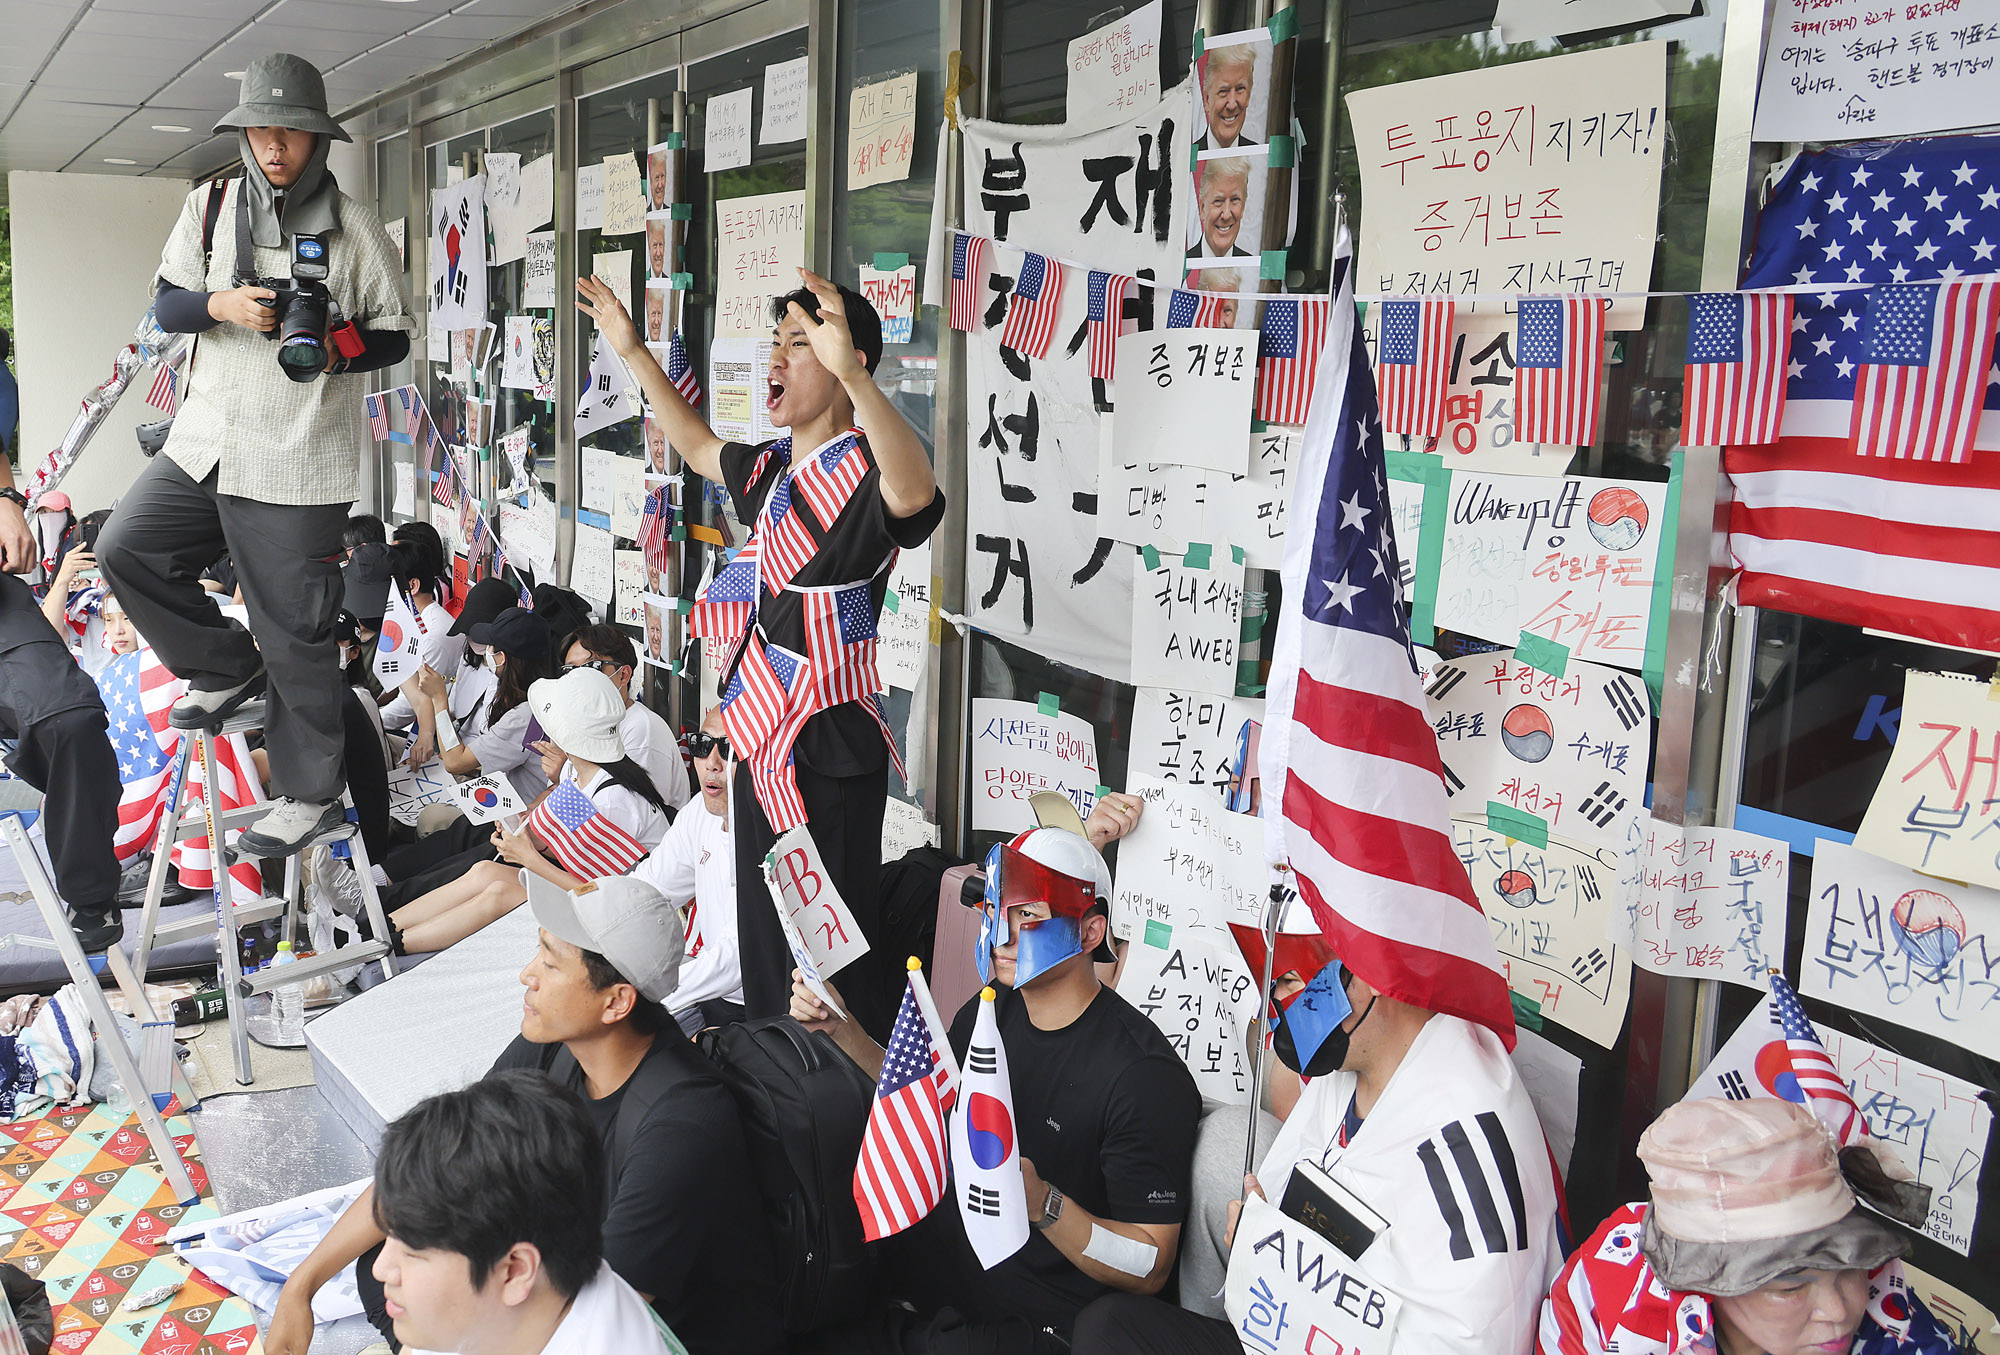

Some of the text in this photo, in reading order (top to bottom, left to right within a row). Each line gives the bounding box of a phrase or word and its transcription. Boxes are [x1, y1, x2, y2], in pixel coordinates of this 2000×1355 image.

[1075, 24, 1131, 71] 공정한 선거를
[1111, 39, 1154, 76] 원합니다
[1781, 47, 1827, 68] 여기는
[1907, 30, 1940, 56] 투표
[1950, 22, 2000, 49] 개표소
[1790, 56, 1994, 95] 입니다. 핸드볼 경기장이
[1381, 105, 1657, 186] 투표용지 지키자!
[724, 204, 804, 245] 투표용지 지키자!
[1413, 188, 1563, 251] 증거보존
[735, 246, 779, 281] 증거보존
[722, 294, 762, 330] 부정선거
[862, 273, 914, 321] 재선거
[1148, 343, 1244, 387] 증거보존
[1128, 486, 1166, 529] 대빵
[898, 575, 929, 602] 수개표
[1532, 552, 1662, 592] 당일투표
[1154, 568, 1197, 621] 국내
[1520, 590, 1655, 657] 수개표
[1485, 659, 1581, 706] 부정선거
[979, 717, 1097, 773] 사전투표 없애고
[1433, 711, 1487, 741] 일투표
[1568, 732, 1630, 775] 수개표
[985, 767, 1048, 801] 당일투표
[1498, 777, 1563, 826] 재선거
[1163, 846, 1214, 891] 부정선거
[1120, 890, 1172, 920] 시민입니다
[1160, 949, 1250, 1003] A-WEB
[1140, 984, 1239, 1043] 부정선거
[1046, 1116, 1061, 1132] Jeep
[1846, 1079, 1936, 1141] 선거
[1162, 1190, 1176, 1198] Jeep
[1253, 1229, 1387, 1330] AWEB
